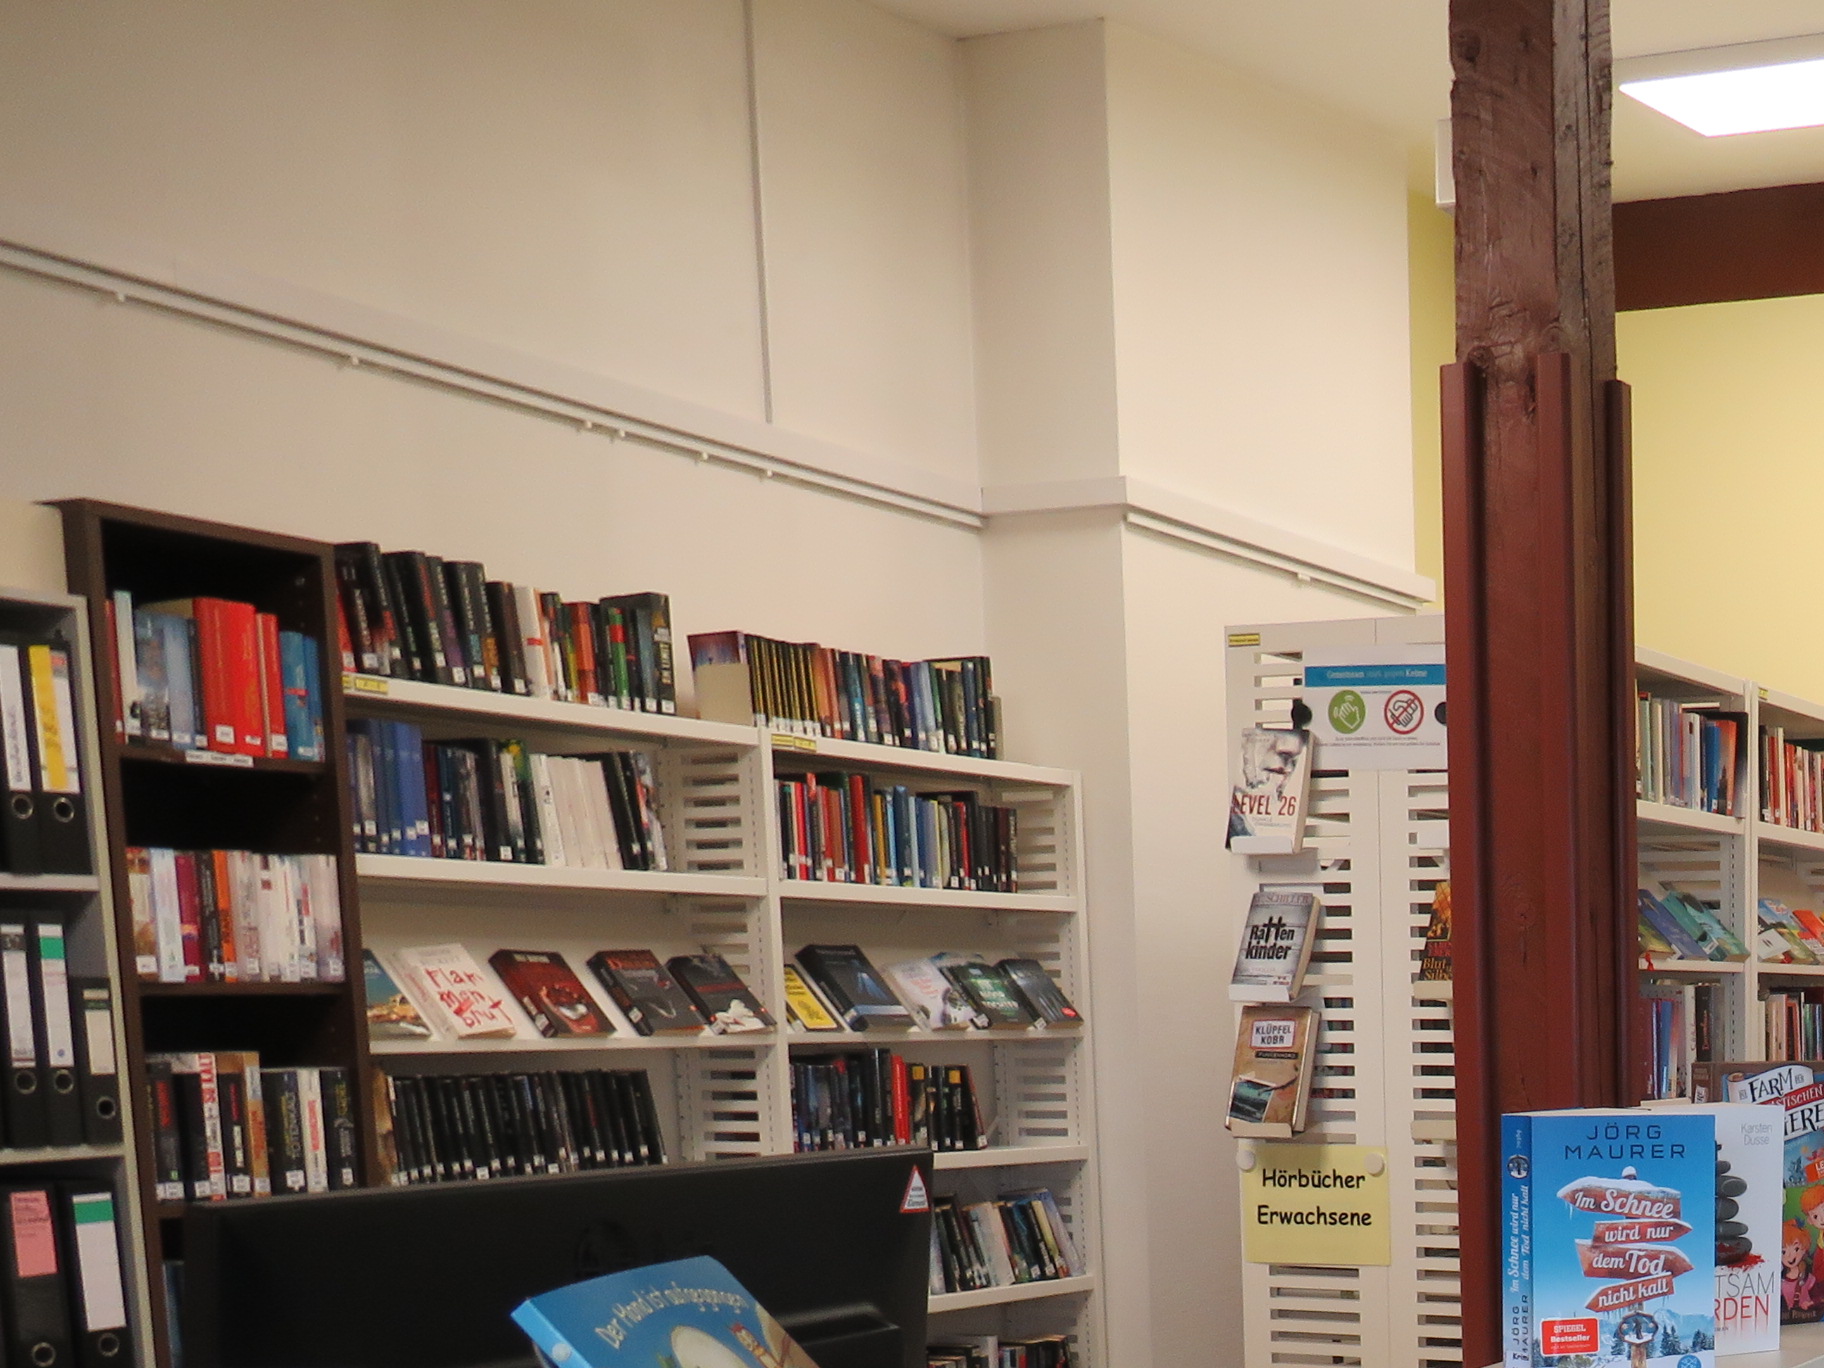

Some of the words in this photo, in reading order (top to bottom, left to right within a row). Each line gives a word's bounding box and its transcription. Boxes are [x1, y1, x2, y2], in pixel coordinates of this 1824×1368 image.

[1232, 794, 1271, 816] LEVEL
[1277, 796, 1297, 816] 26
[1249, 916, 1295, 942] Ratten
[1245, 941, 1292, 961] kinder
[1748, 1067, 1794, 1103] FARM
[1586, 1122, 1662, 1140] JÖRG
[1740, 1122, 1773, 1134] Karsten
[1743, 1134, 1770, 1145] Dusse
[1564, 1143, 1686, 1160] MAURER
[1261, 1168, 1366, 1189] Hörbücher
[1574, 1192, 1597, 1210] Im
[1600, 1187, 1674, 1219] Schnee
[1257, 1205, 1373, 1226] Erwachsene
[1604, 1224, 1641, 1242] wird
[1646, 1226, 1674, 1240] nur
[1507, 1235, 1520, 1278] Schnee
[1592, 1254, 1625, 1269] dem
[1625, 1249, 1667, 1275] Tod
[1598, 1286, 1636, 1309] nicht
[1638, 1278, 1669, 1300] kalt
[594, 1318, 628, 1350] Der
[1511, 1305, 1520, 1345] JÖRG
[1553, 1324, 1587, 1333] SPIEGEL
[1550, 1334, 1591, 1343] Bestseller
